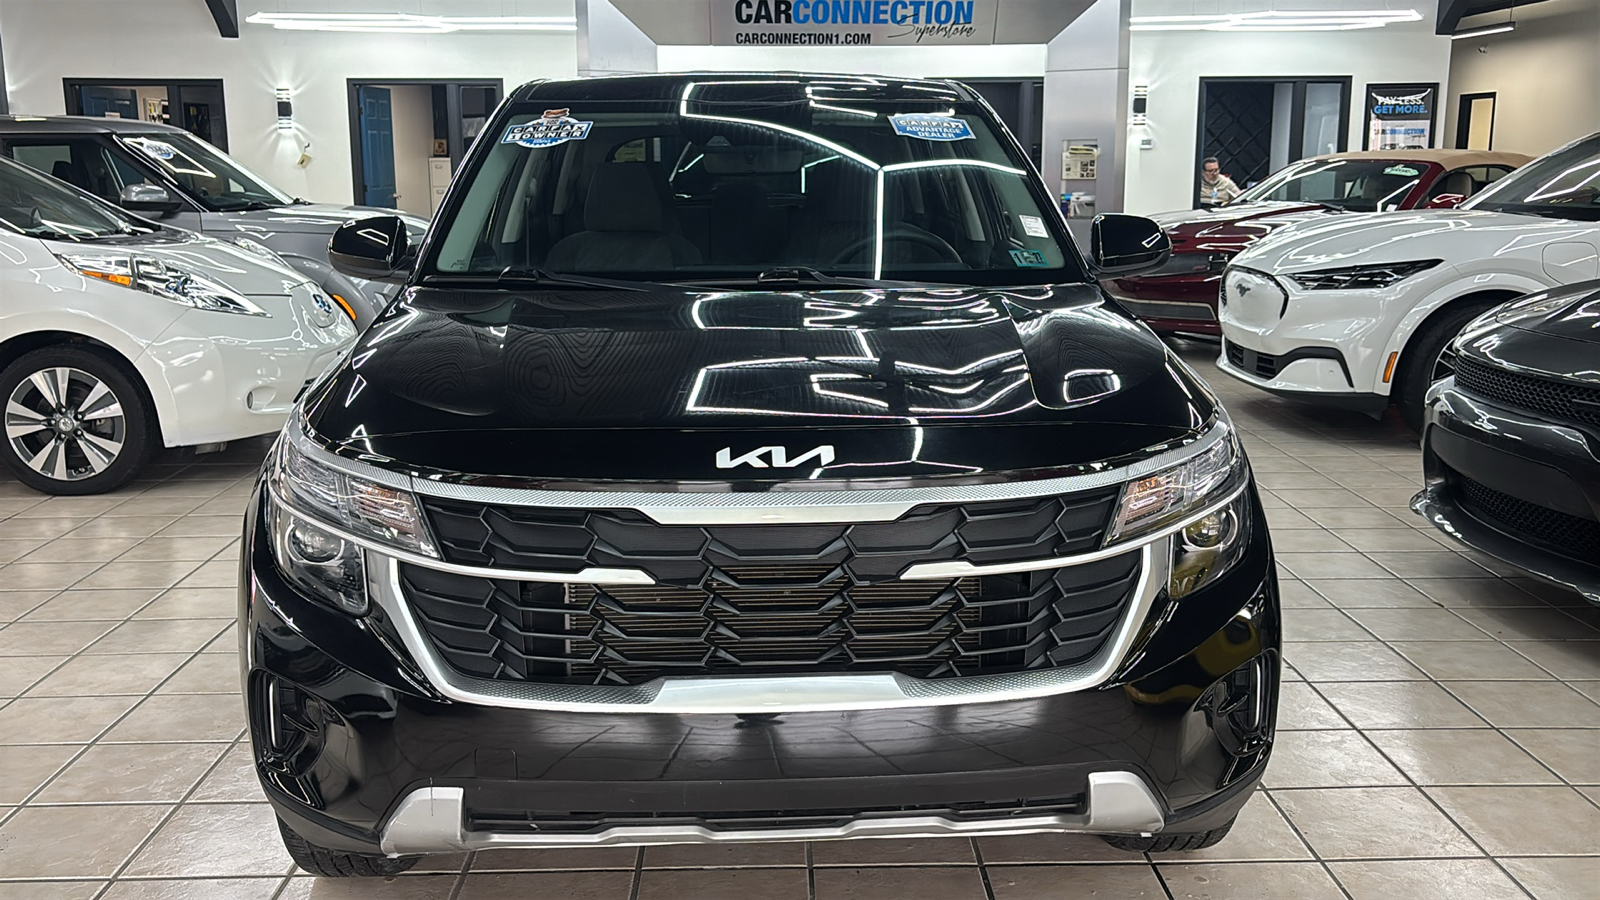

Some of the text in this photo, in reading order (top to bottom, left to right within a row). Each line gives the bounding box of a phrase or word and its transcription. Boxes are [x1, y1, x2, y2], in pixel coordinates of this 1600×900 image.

[735, 0, 974, 25] CARCONNECTION
[888, 14, 977, 44] Superstore
[735, 33, 872, 45] CARCONNECTION1.COM
[1374, 105, 1428, 114] GET MORE.
[512, 125, 585, 133] CARFAX
[898, 120, 964, 129] CARFAX
[906, 126, 962, 134] ADVANTAGE
[521, 131, 583, 140] OWNER
[917, 131, 955, 139] DEALER
[716, 445, 835, 468] KIA
